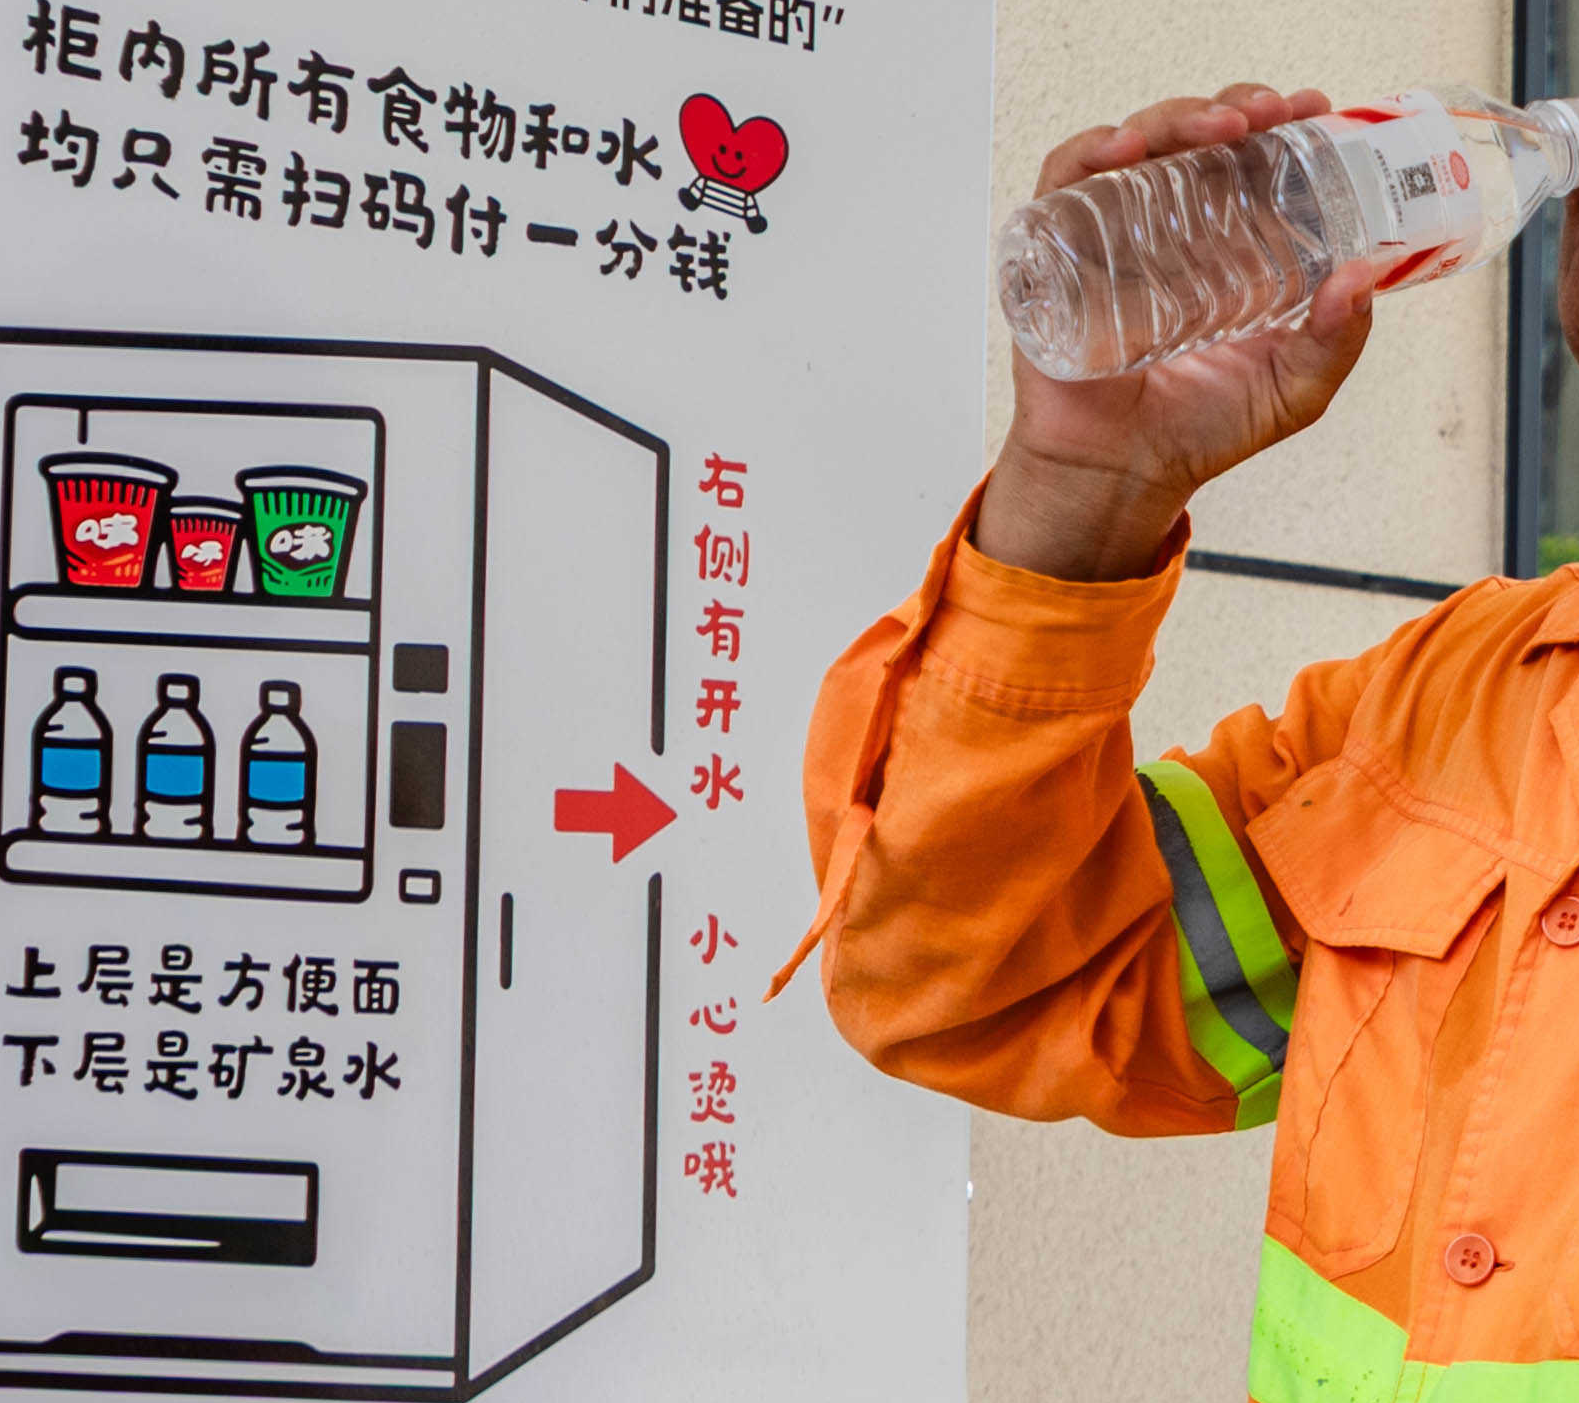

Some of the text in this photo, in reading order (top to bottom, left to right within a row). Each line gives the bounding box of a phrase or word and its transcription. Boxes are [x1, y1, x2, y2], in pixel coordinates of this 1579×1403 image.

[16, 108, 732, 302] 均只需扫码付一分钱
[684, 451, 750, 1198] 右侧有开水 小心烫哦
[5, 943, 401, 1016] 上层是方便面
[2, 1031, 401, 1101] 下层是矿泉水
